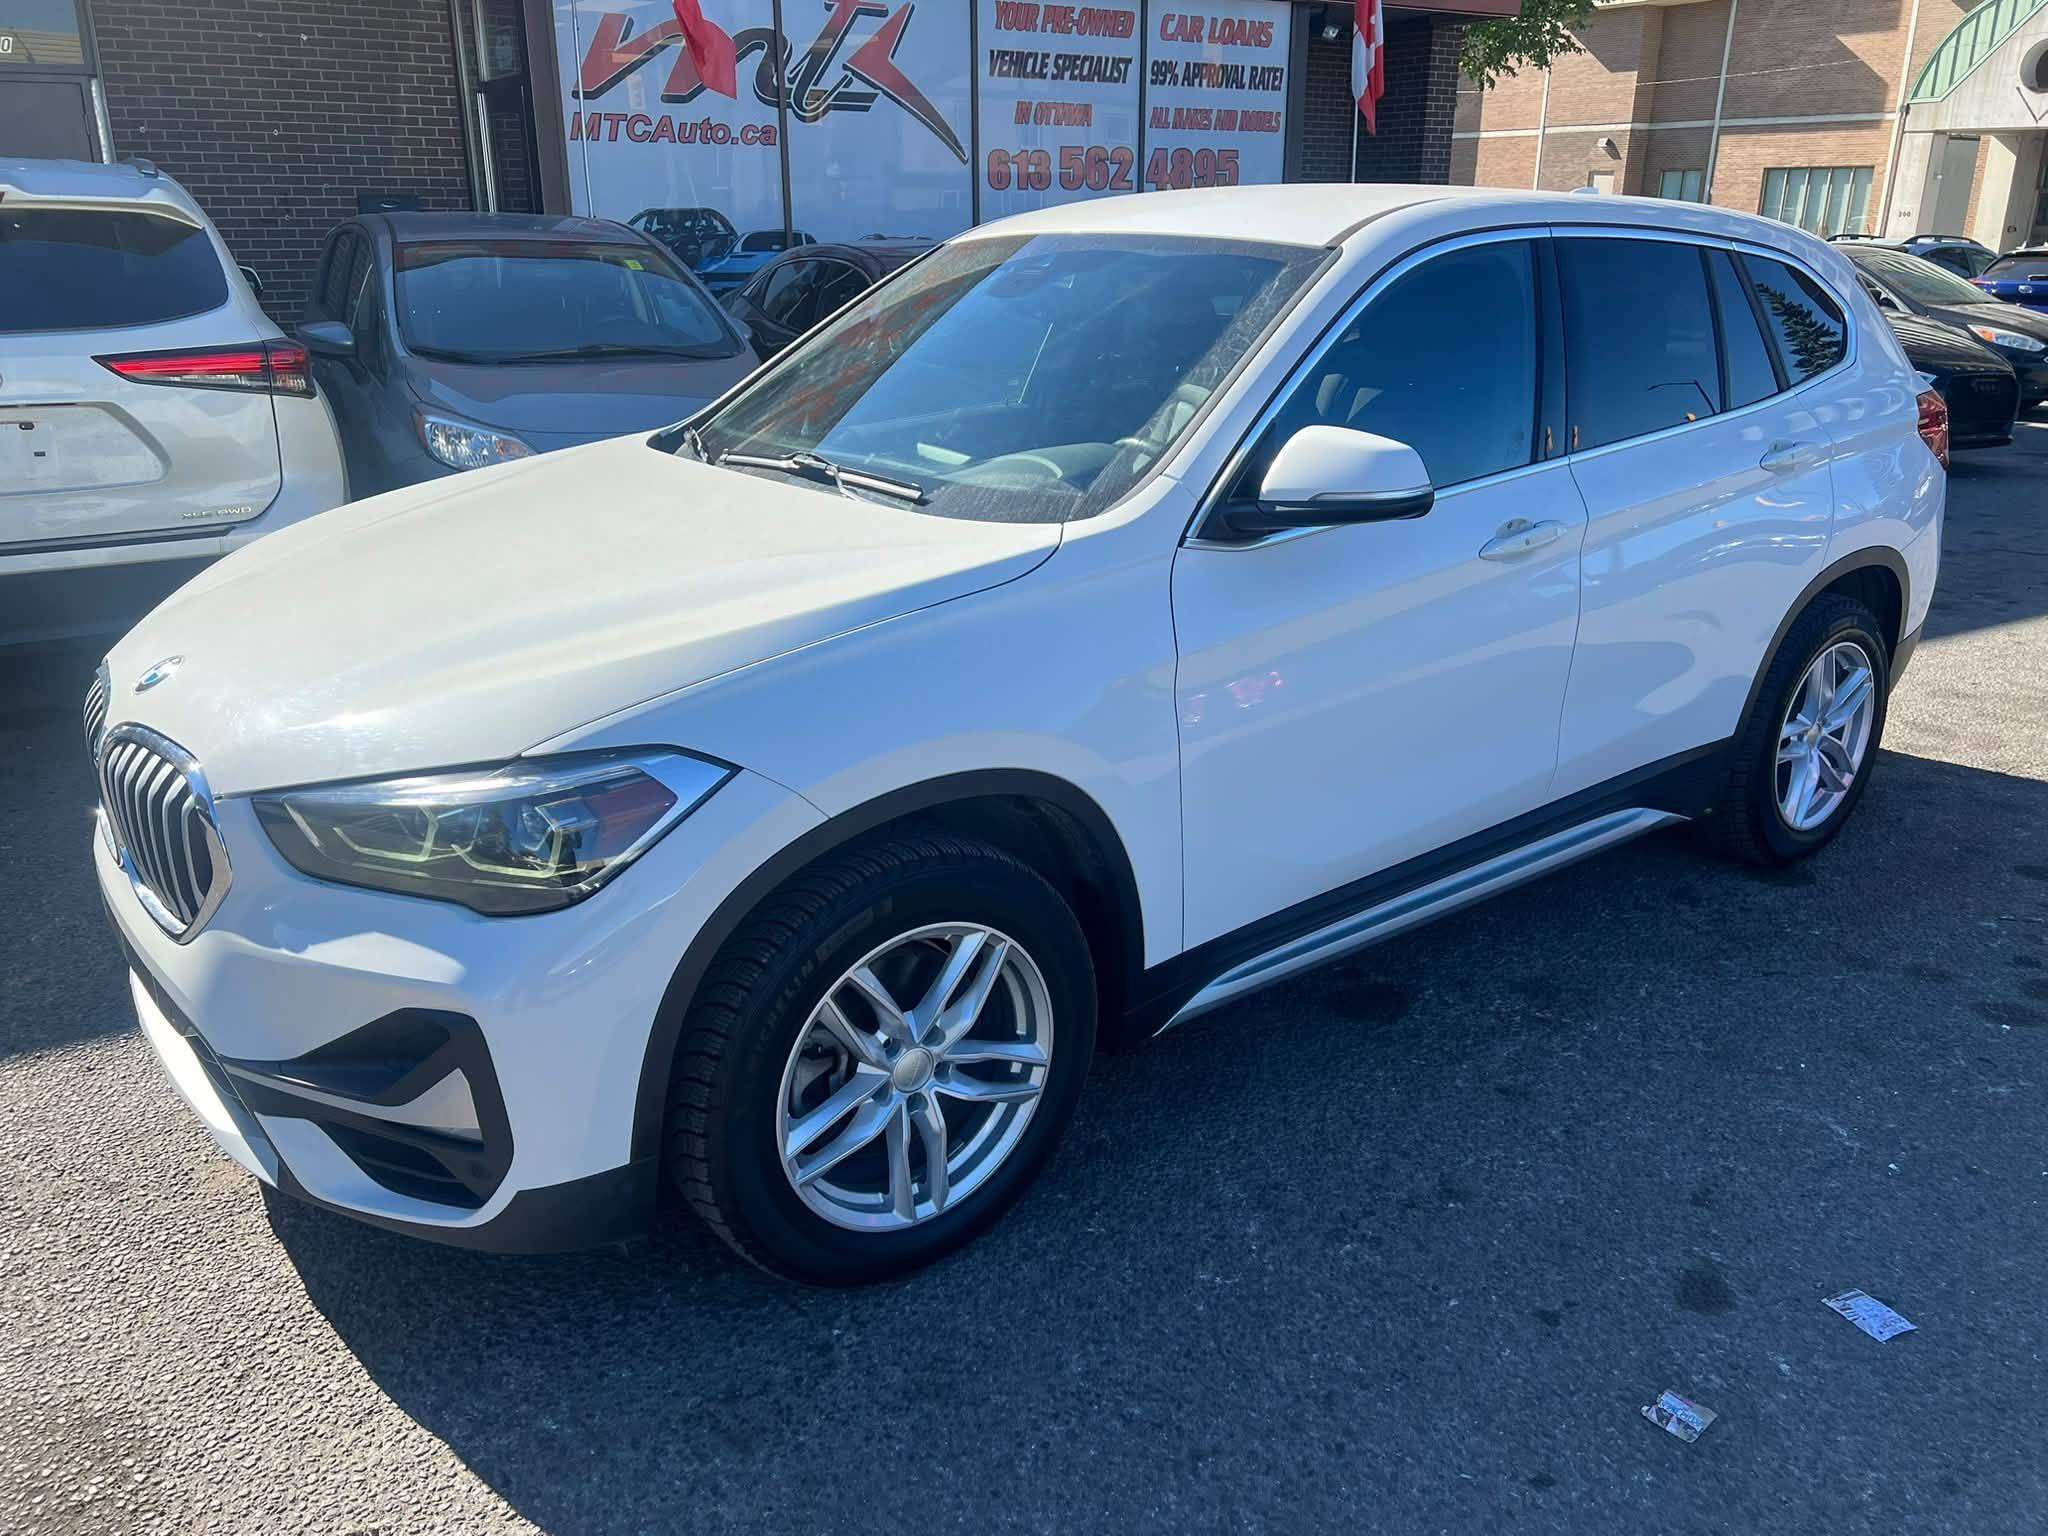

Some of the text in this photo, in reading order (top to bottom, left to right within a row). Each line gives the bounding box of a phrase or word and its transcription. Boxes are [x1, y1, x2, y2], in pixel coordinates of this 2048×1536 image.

[995, 1, 1136, 39] YOUR PRE-OWNED
[1160, 13, 1274, 48] CAR LOANS
[989, 49, 1133, 84] VEHICLE SPECIALIST
[1150, 59, 1285, 92] 99% APPROVAL RATE!
[570, 112, 778, 146] MTCAuto.ca
[1014, 101, 1093, 127] IN OTTAWA
[1149, 107, 1282, 133] ALL MAKES AND MODELS
[987, 145, 1240, 191] 613 562 4895
